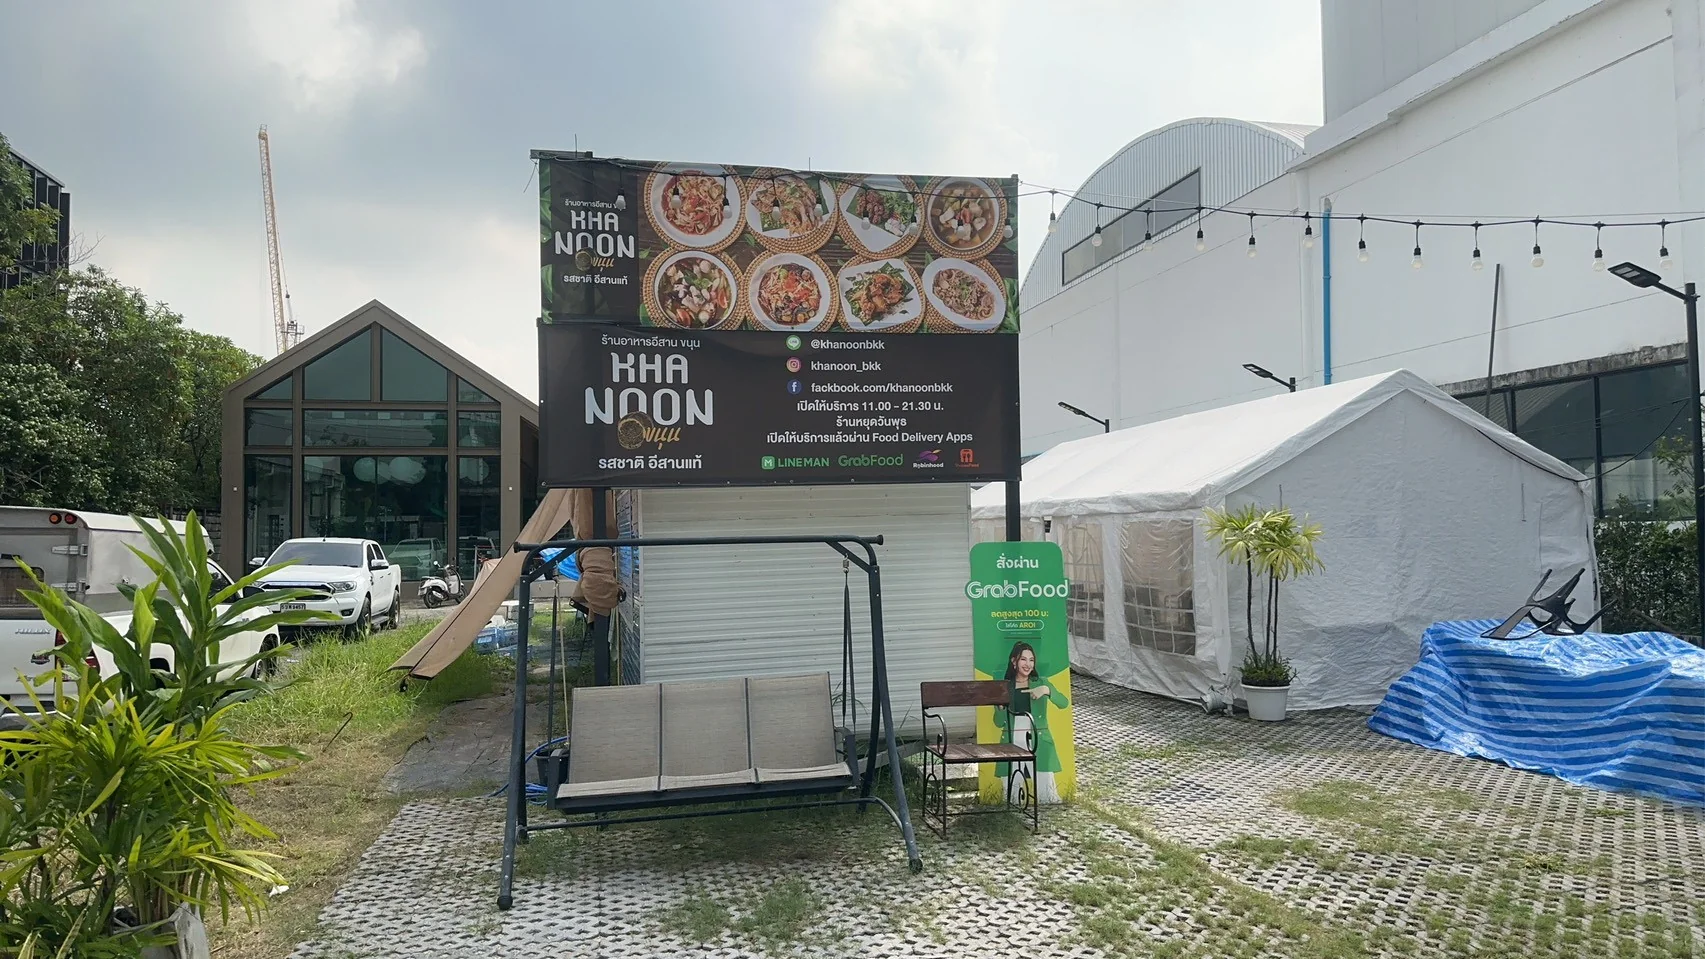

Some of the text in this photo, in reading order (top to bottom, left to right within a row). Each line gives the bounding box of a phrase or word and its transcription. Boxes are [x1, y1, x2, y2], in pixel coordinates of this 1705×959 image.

[570, 210, 619, 231] KHA
[555, 231, 635, 258] NOON
[563, 275, 628, 285] รสชาติ อีสานแท้
[601, 334, 701, 350] ร้านอาหารอีสาน ขนุน
[810, 339, 886, 350] @khanoonbkk
[610, 352, 689, 384] KHA
[811, 361, 882, 373] khanoon_bkk
[811, 382, 954, 393] fackbook.com/khanoonbkk
[585, 387, 714, 426] NOON
[797, 400, 860, 411] เปิดให้บริการ
[862, 402, 892, 411] 11.00
[901, 402, 931, 411] 21.30
[836, 416, 907, 430] ร้านหยุดวันพุธ
[767, 431, 973, 444] เปิดให้บริการแล้วผ่าน Food Delivery Apps
[598, 454, 703, 469] รสชาติ อีสานแท้
[838, 454, 904, 467] GrabFood
[996, 553, 1039, 569] สั่งผ่าน
[966, 580, 1069, 599] GrabFood
[1024, 609, 1040, 617] 100
